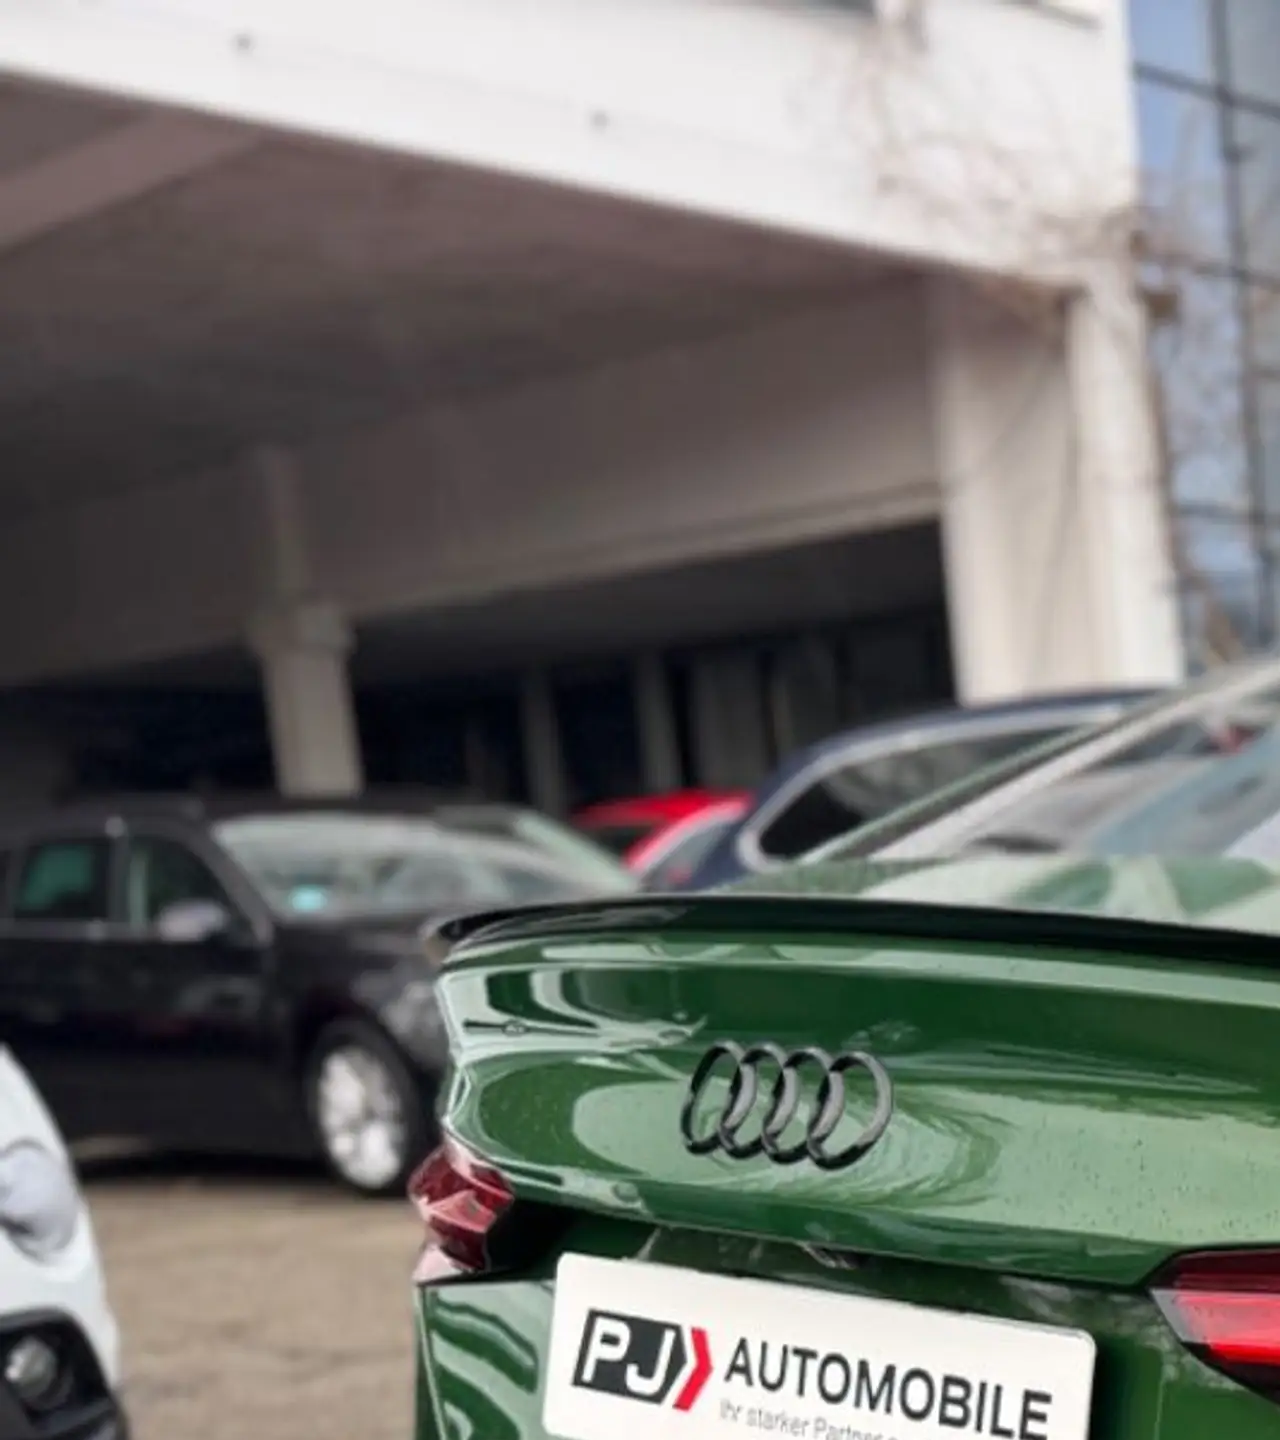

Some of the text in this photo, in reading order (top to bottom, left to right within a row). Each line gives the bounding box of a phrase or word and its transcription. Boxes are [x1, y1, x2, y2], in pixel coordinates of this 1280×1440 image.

[580, 1315, 676, 1395] PJ
[720, 1399, 743, 1422] Ihr
[745, 1407, 810, 1438] starker
